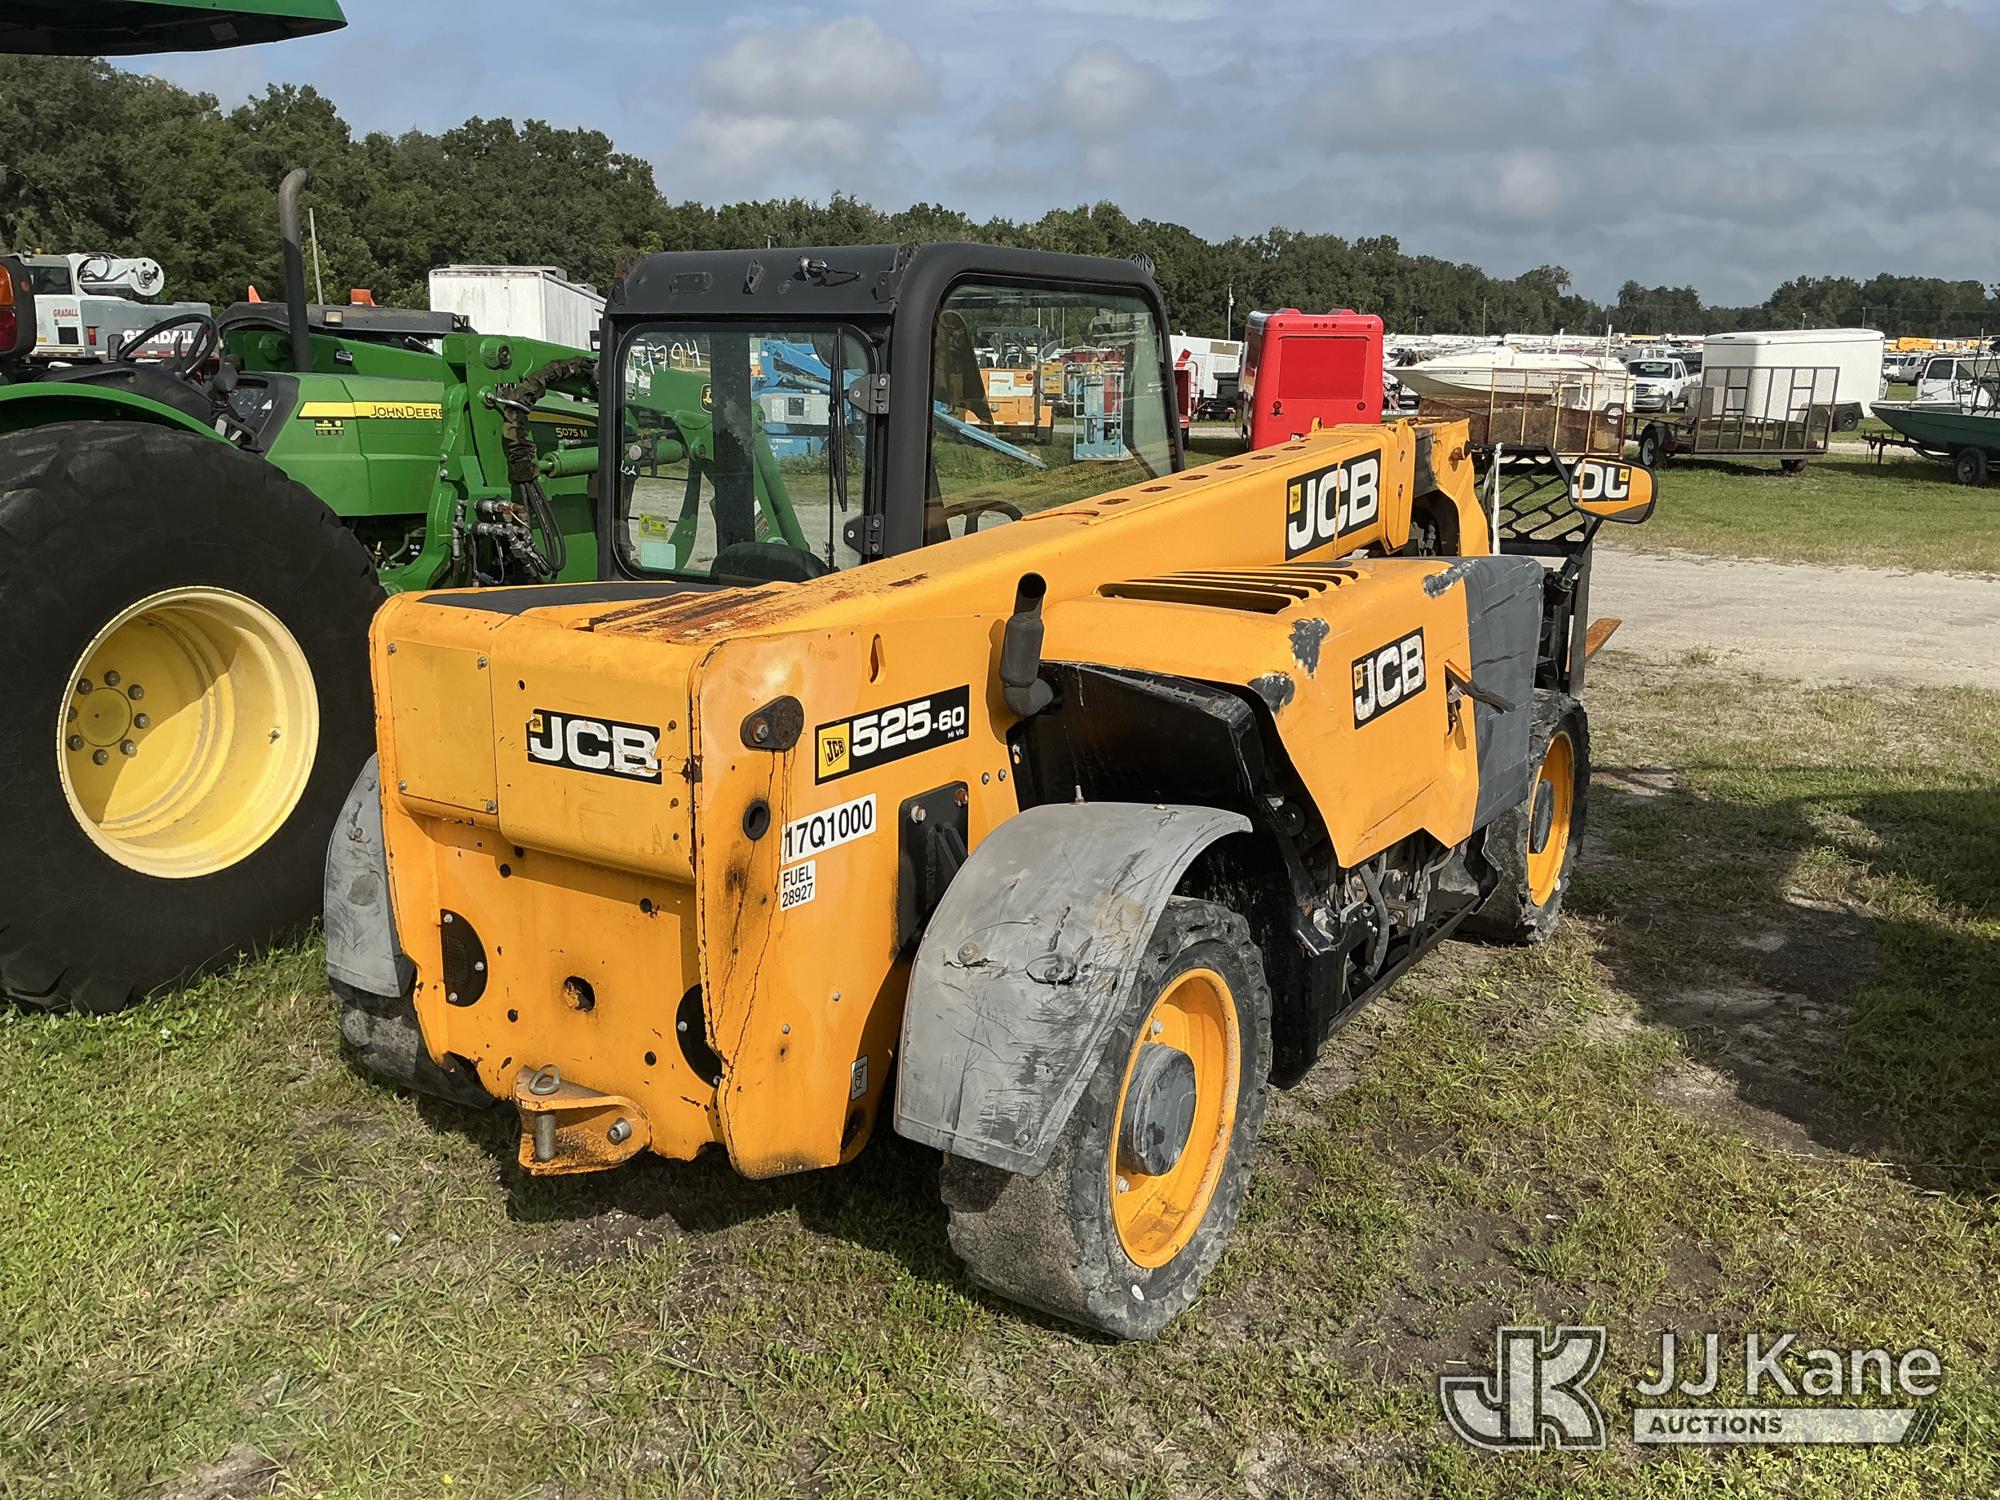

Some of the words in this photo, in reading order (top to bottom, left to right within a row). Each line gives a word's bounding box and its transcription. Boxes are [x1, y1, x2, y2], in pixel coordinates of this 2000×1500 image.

[53, 308, 78, 317] GRADALL
[371, 405, 404, 417] JOHN
[406, 405, 443, 418] DEERE
[555, 427, 579, 438] 5075
[580, 429, 588, 438] M
[1288, 458, 1378, 550] JCB
[1355, 634, 1425, 721] JCB
[530, 715, 659, 778] JCB
[826, 739, 846, 763] JCB
[785, 799, 873, 857] 17Q1000
[783, 864, 812, 889] FUEL
[782, 882, 813, 908] 28927
